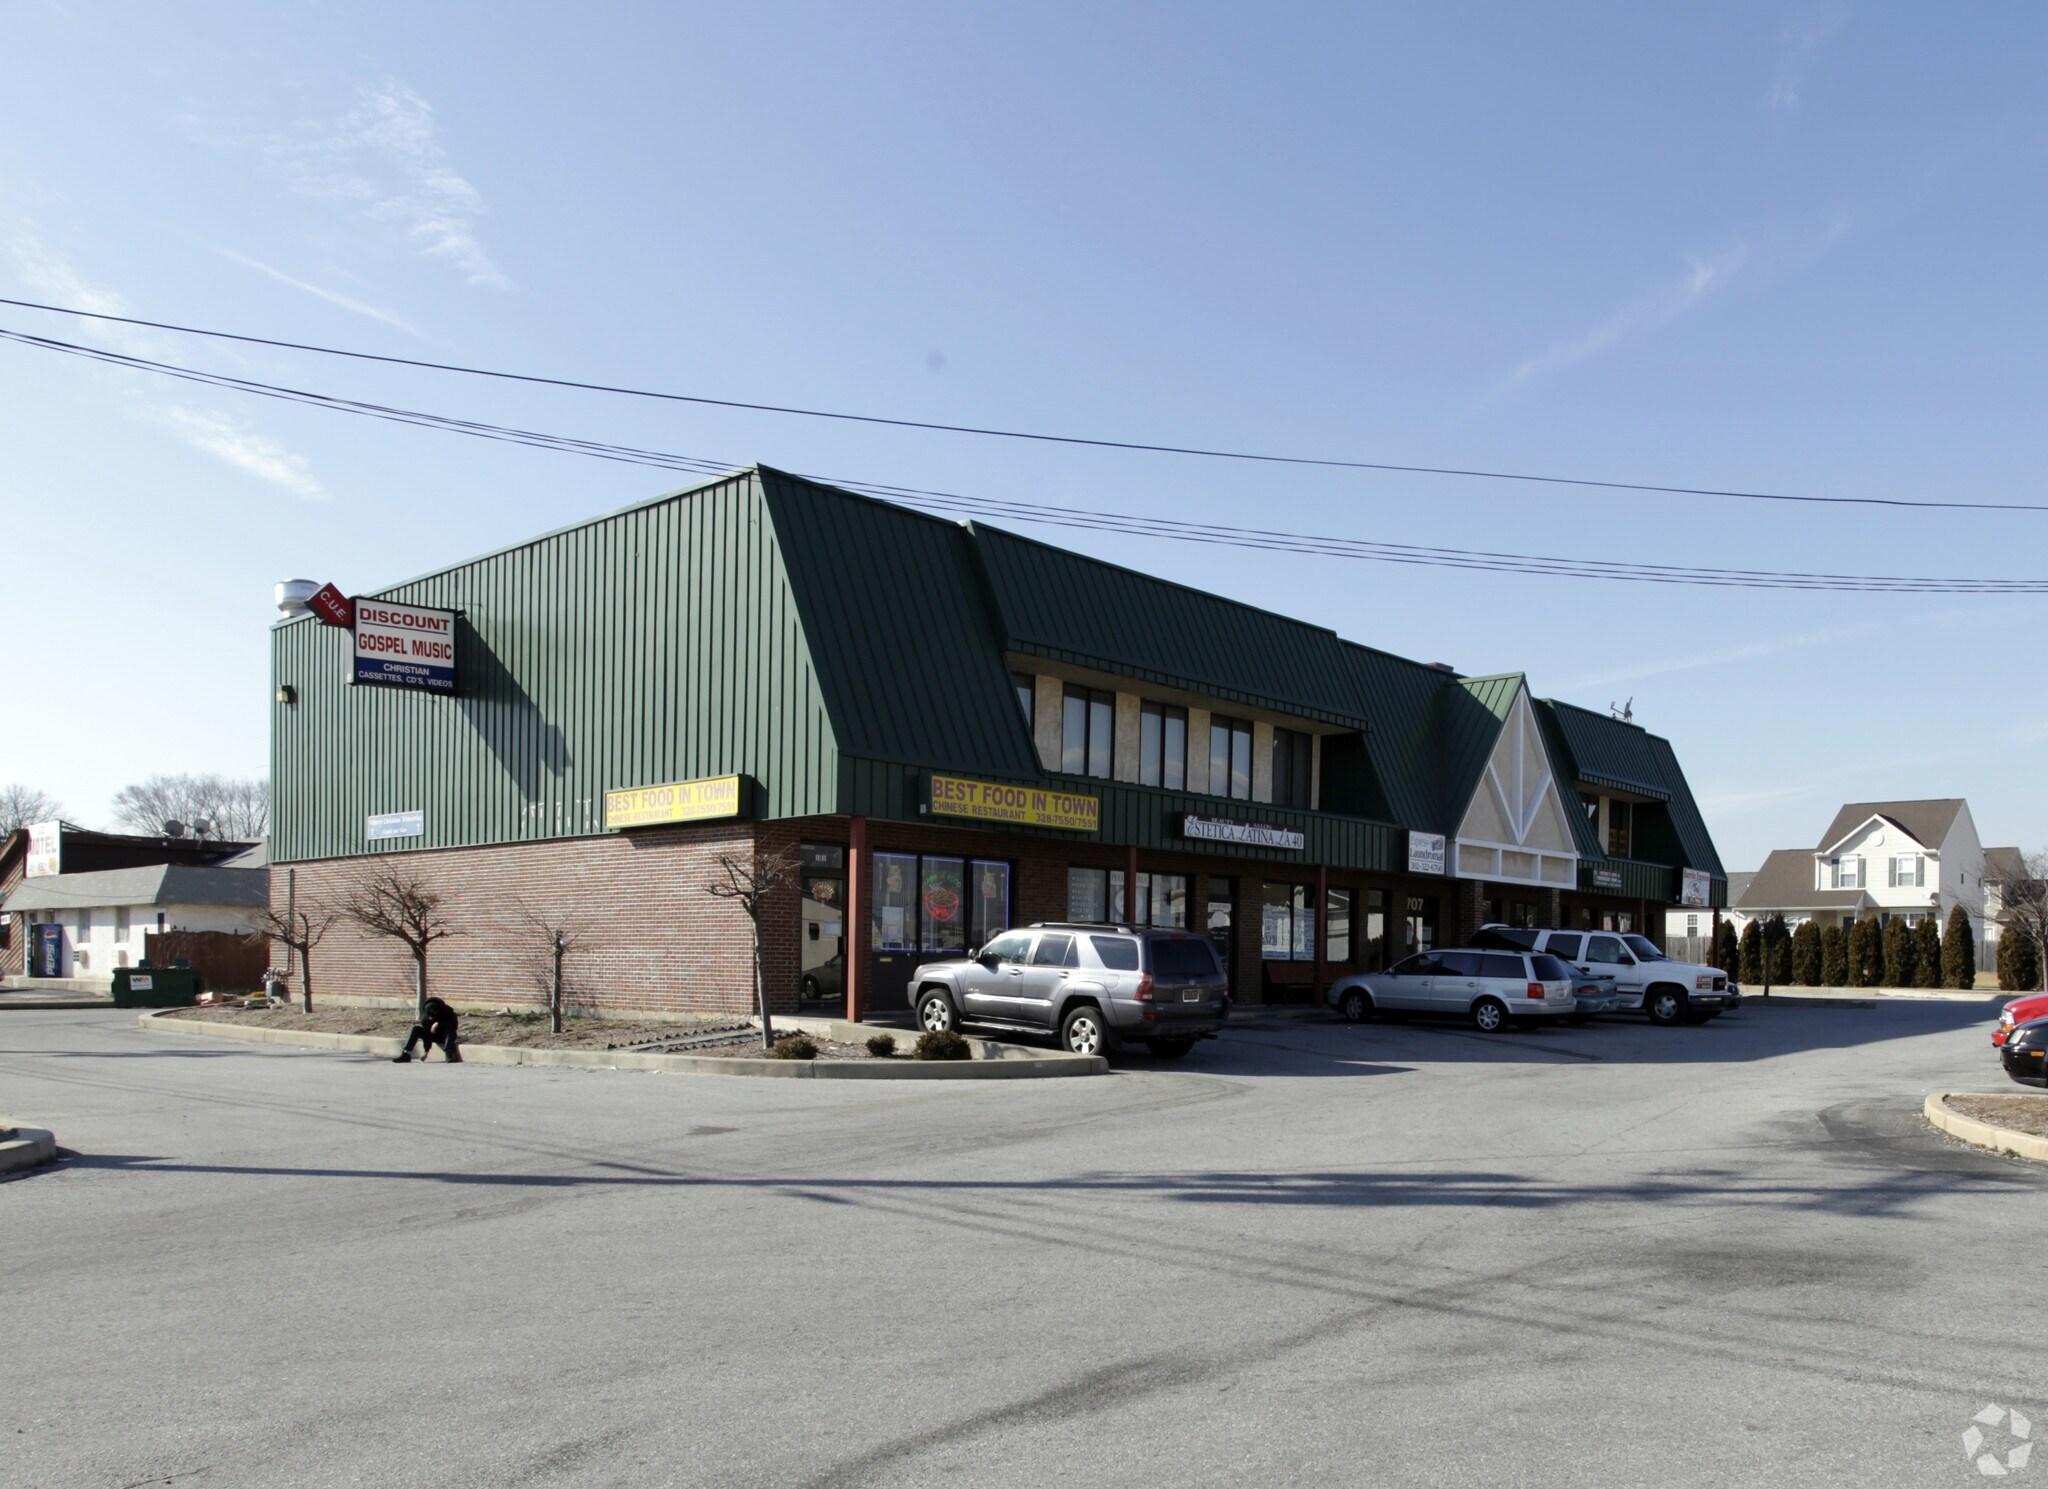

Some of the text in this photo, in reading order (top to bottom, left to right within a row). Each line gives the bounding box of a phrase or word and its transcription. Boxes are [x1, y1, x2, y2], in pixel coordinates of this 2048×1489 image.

[320, 591, 347, 621] C.U.E.
[360, 608, 450, 631] DISCOUNT
[359, 633, 452, 660] GOSPEL MUSIC
[383, 663, 430, 676] CHRISTIAN
[427, 679, 453, 688] VIDEOS
[606, 780, 736, 813] BEST FOOD IN TOWN
[933, 779, 1097, 817] BEST FOOD IN TOWN
[607, 813, 632, 824] CHINESE
[633, 808, 673, 820] RESTAURANT
[933, 800, 1097, 828] CHINESE RESTAURANT 328-7550/7551
[1187, 815, 1303, 848] ESTETICA LATINA LA 40
[1410, 848, 1444, 861] Laundromat
[1407, 897, 1424, 911] 707
[46, 944, 56, 976] PEPSI
